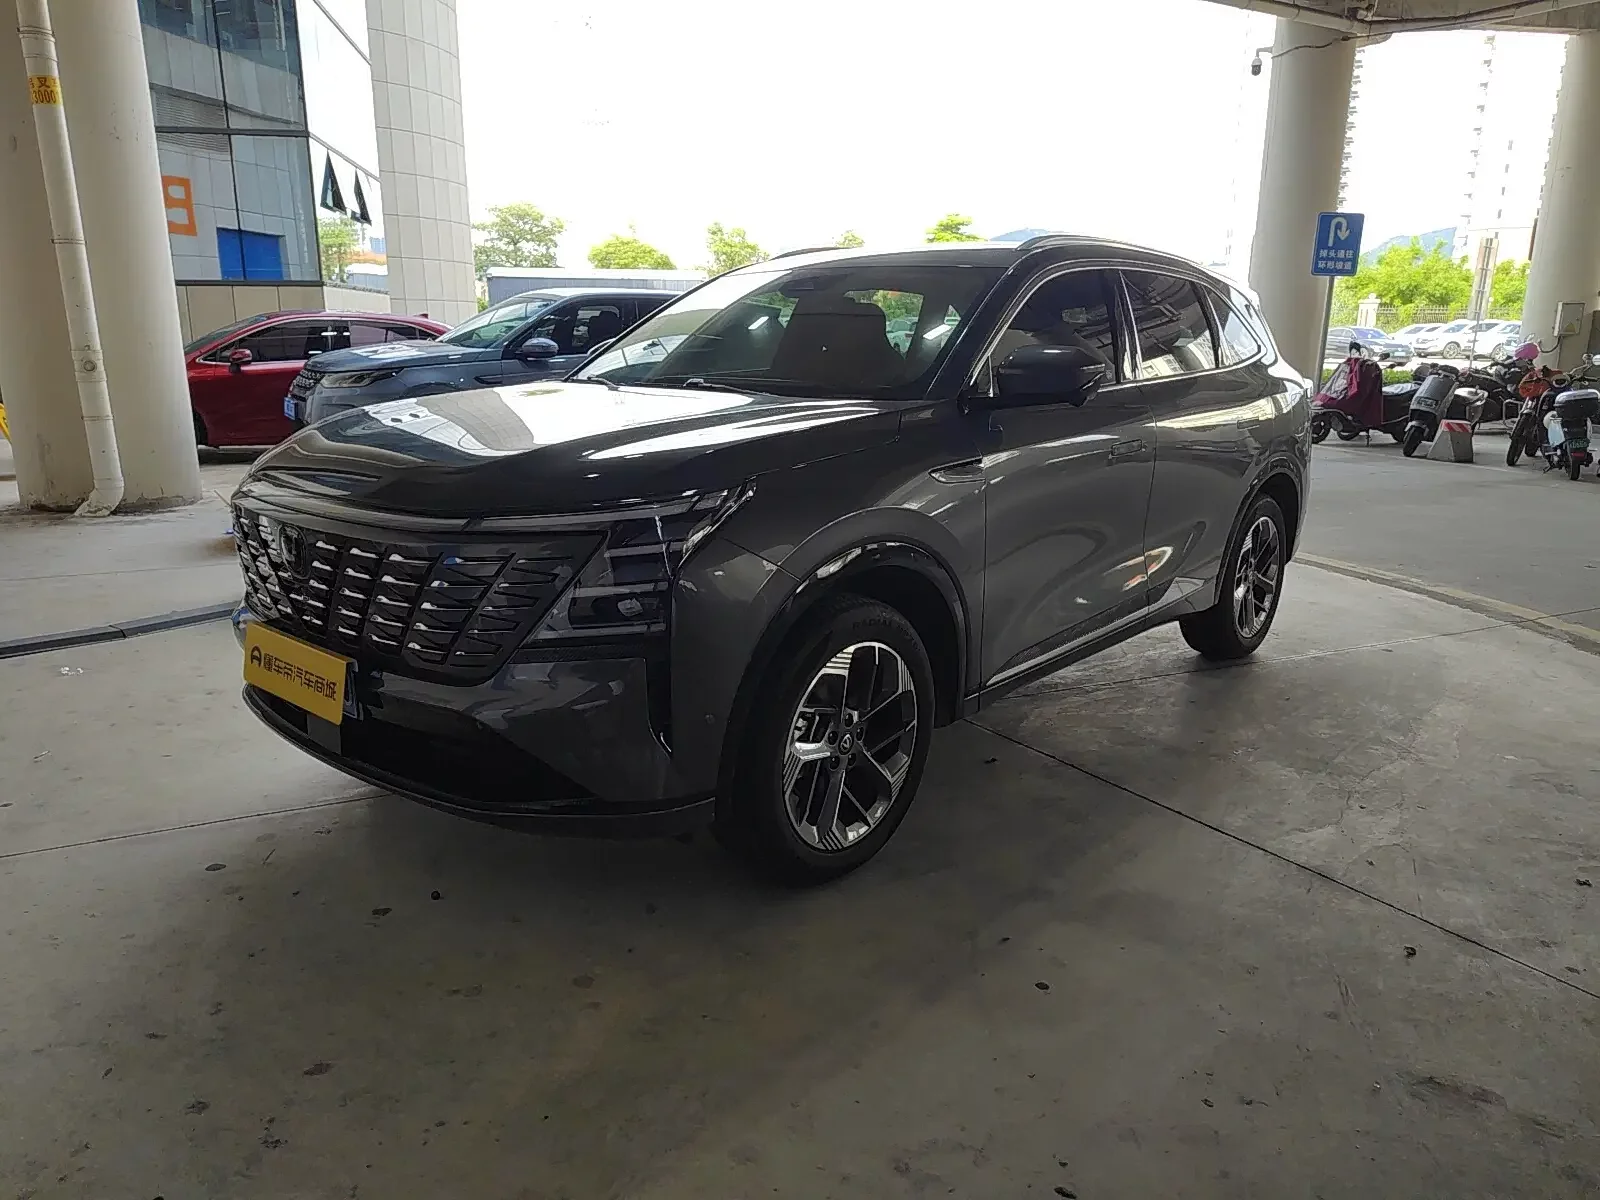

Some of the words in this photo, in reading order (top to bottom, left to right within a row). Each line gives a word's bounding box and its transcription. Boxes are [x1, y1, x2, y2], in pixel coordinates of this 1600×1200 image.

[263, 652, 337, 702] 懂车帝汽车商城
